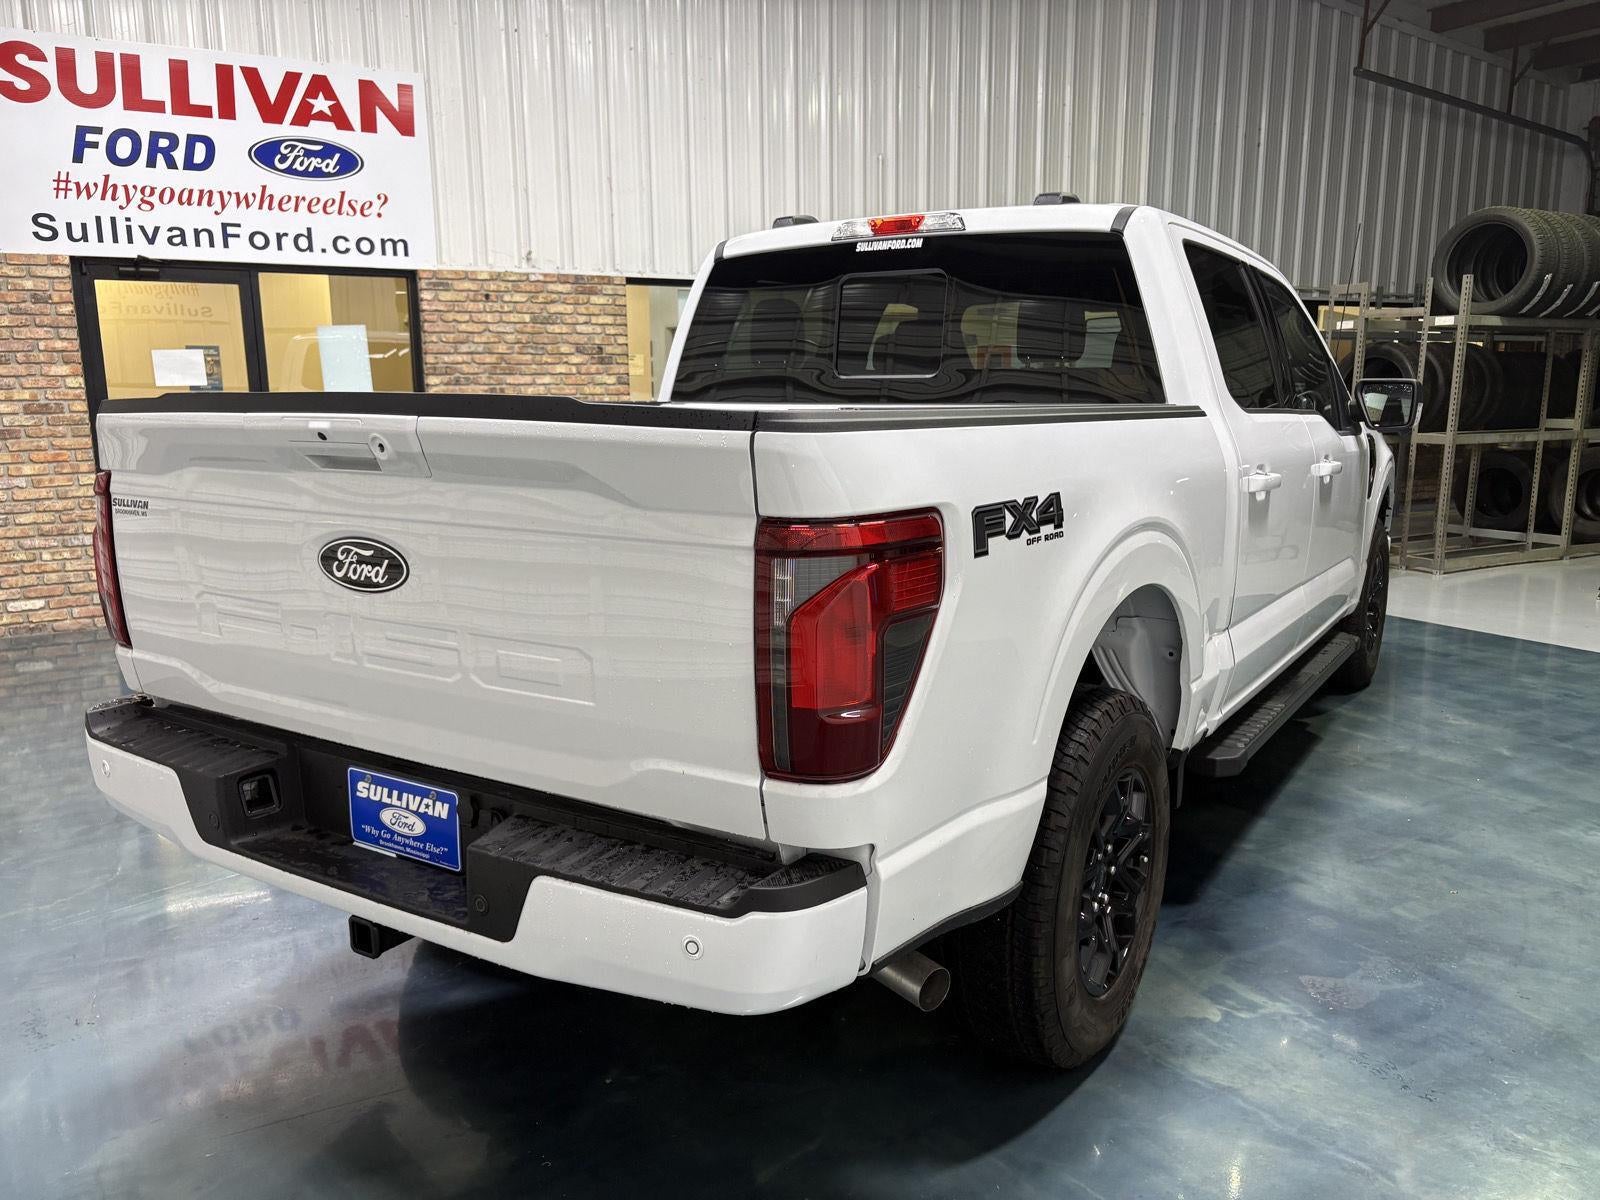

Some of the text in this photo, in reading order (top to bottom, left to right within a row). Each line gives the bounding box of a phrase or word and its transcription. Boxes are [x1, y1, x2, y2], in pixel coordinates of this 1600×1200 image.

[0, 40, 416, 137] SULLIVAN
[71, 124, 216, 172] FORD
[273, 140, 341, 175] Ford
[52, 171, 389, 219] #whygoanywhereelse?
[31, 212, 410, 257] SullivanFord.com
[855, 238, 924, 252] SULLIVANFORD.COM
[112, 498, 149, 509] SULLIVAN
[971, 491, 1064, 559] FX4
[1026, 531, 1064, 546] OFF ROAD
[332, 545, 389, 584] Ford
[356, 781, 449, 819] SULLIVAN
[381, 829, 391, 840] Go
[393, 833, 425, 850] Anywhere
[389, 811, 417, 833] Ford
